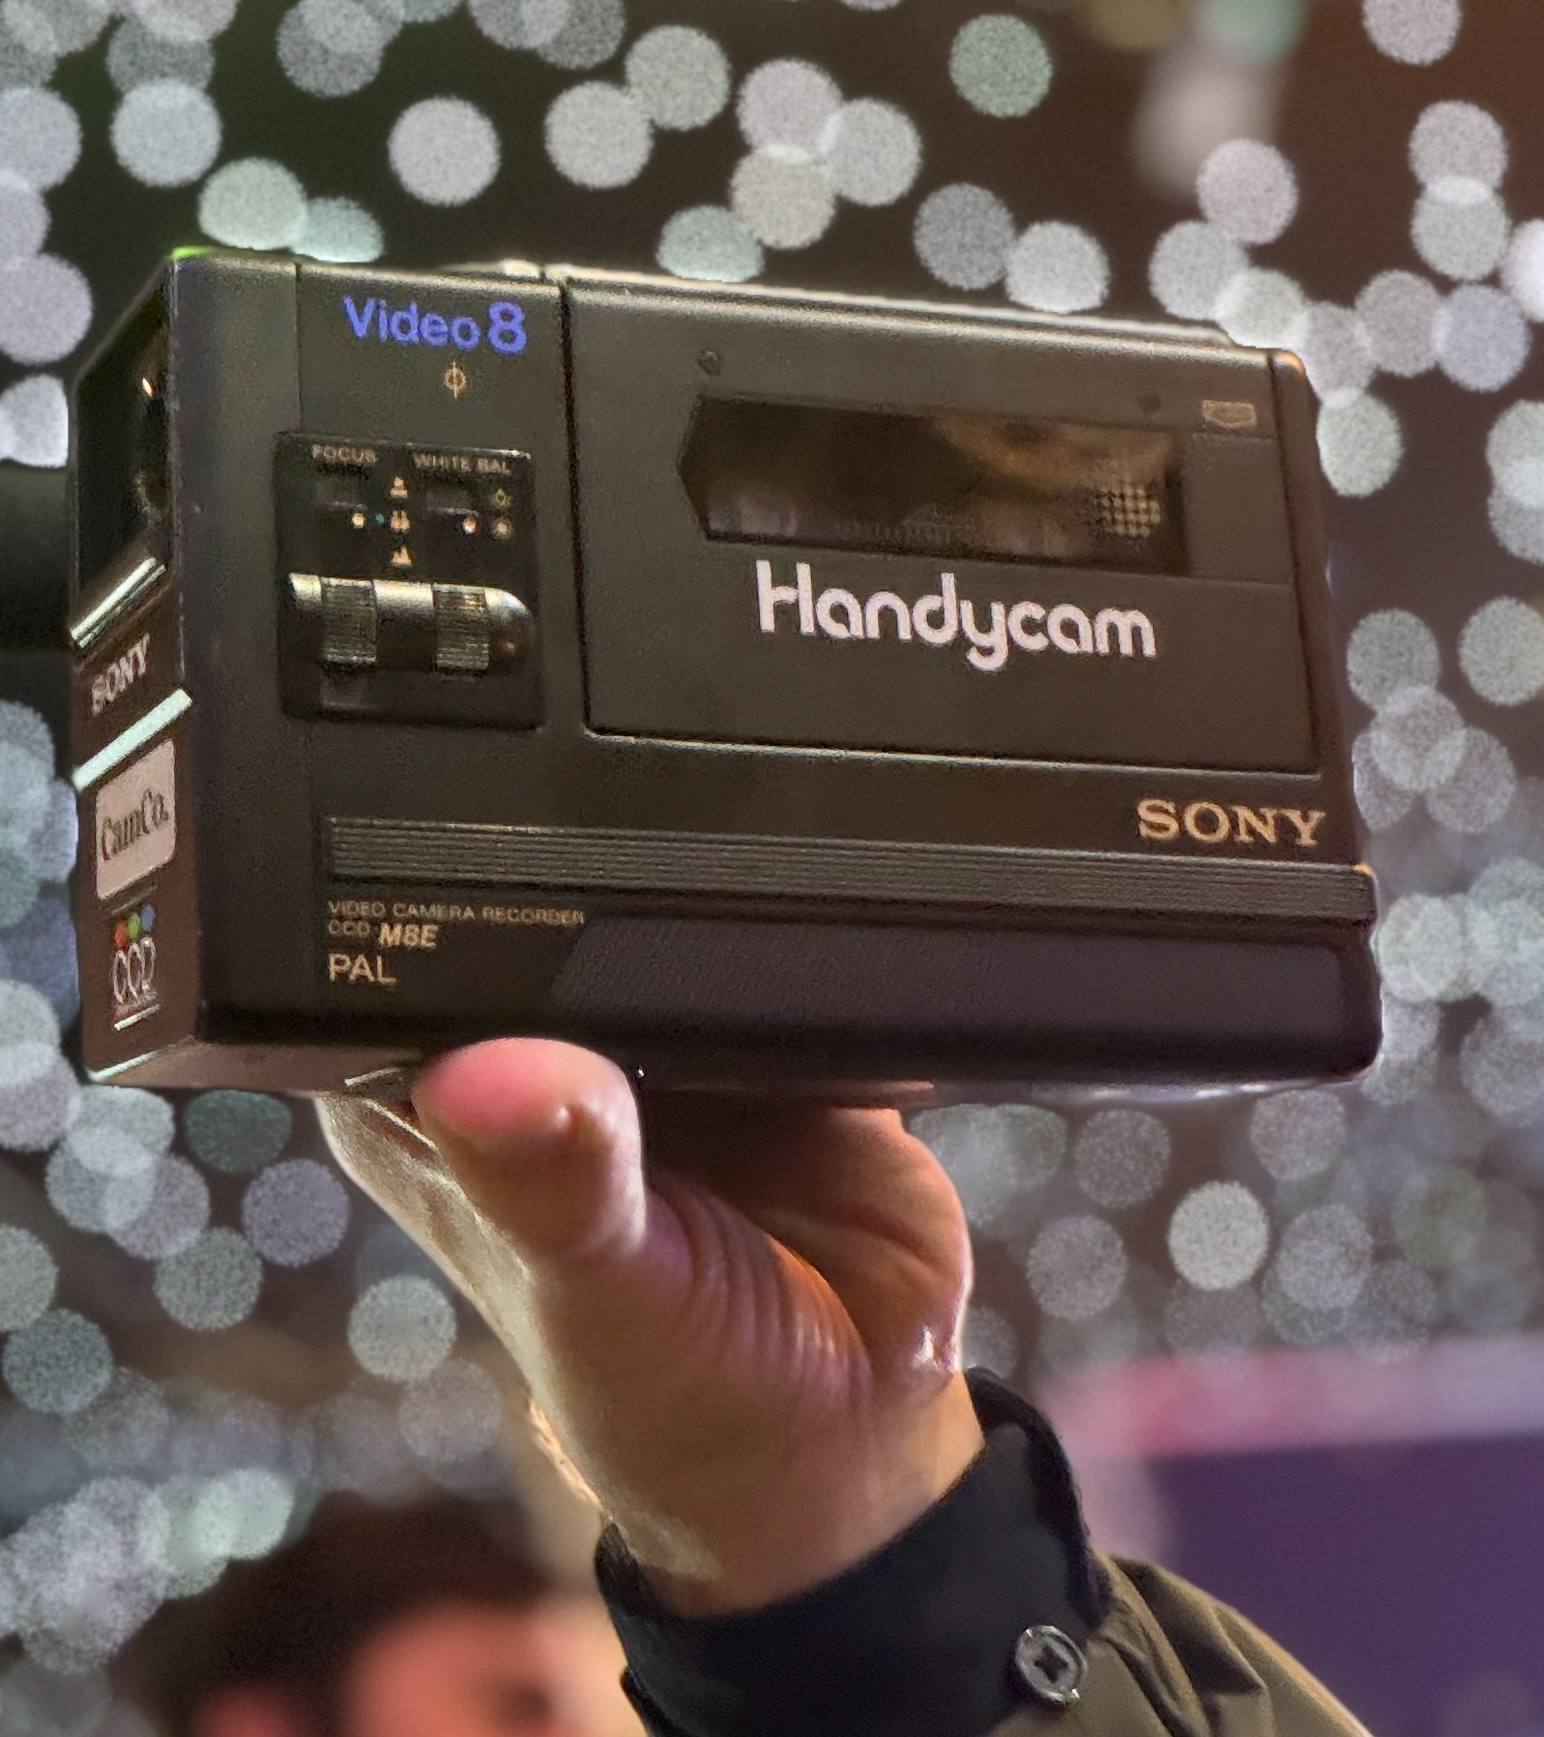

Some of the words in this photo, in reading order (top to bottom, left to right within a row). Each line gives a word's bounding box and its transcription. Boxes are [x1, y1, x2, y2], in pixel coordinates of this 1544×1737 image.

[311, 443, 378, 465] FOCUS
[412, 453, 472, 473] WHITE
[756, 559, 1157, 672] Handycam
[91, 632, 150, 717] SONY
[1137, 798, 1326, 848] SONY
[327, 900, 386, 918] VIDEO
[392, 903, 475, 921] CAMERA
[482, 907, 585, 926] RECORDER
[327, 953, 398, 985] PAL
